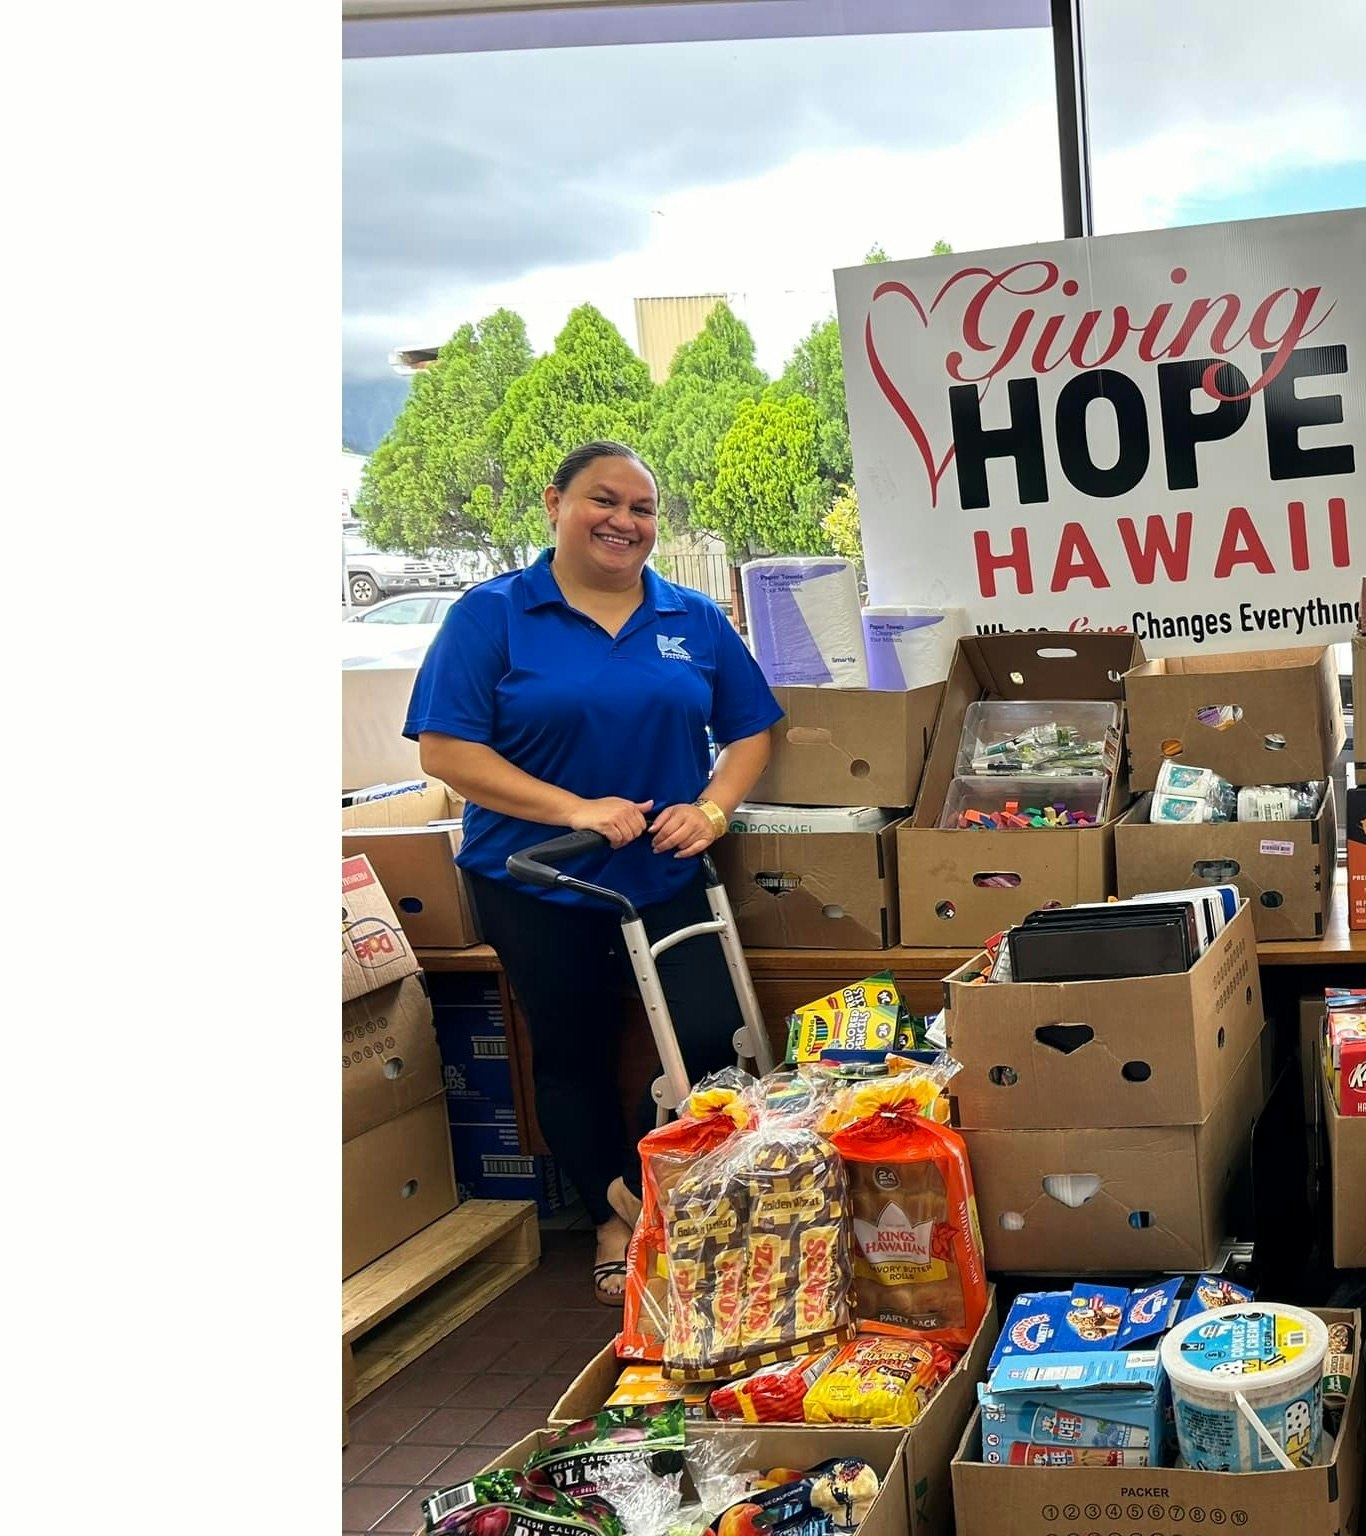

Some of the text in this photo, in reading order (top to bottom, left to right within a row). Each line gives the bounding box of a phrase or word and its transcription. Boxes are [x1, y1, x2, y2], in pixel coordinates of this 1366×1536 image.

[945, 261, 1338, 402] Giving
[948, 343, 1356, 511] HOPE
[973, 497, 1351, 599] HAWAII
[1132, 611, 1232, 643] Changes
[805, 1019, 815, 1053] Crayola
[845, 1009, 859, 1050] OLORED
[878, 1026, 889, 1037] 24
[878, 1170, 896, 1181] 24
[865, 1240, 927, 1256] HAWAIIAN
[1011, 1313, 1051, 1352] DRUMSTICK
[1231, 1323, 1246, 1359] COOKIES
[624, 1344, 646, 1359] 24
[986, 1403, 1000, 1421] 30
[1059, 1415, 1076, 1441] ICEE
[1120, 1487, 1170, 1498] PACKER
[516, 1517, 544, 1531] FRESH
